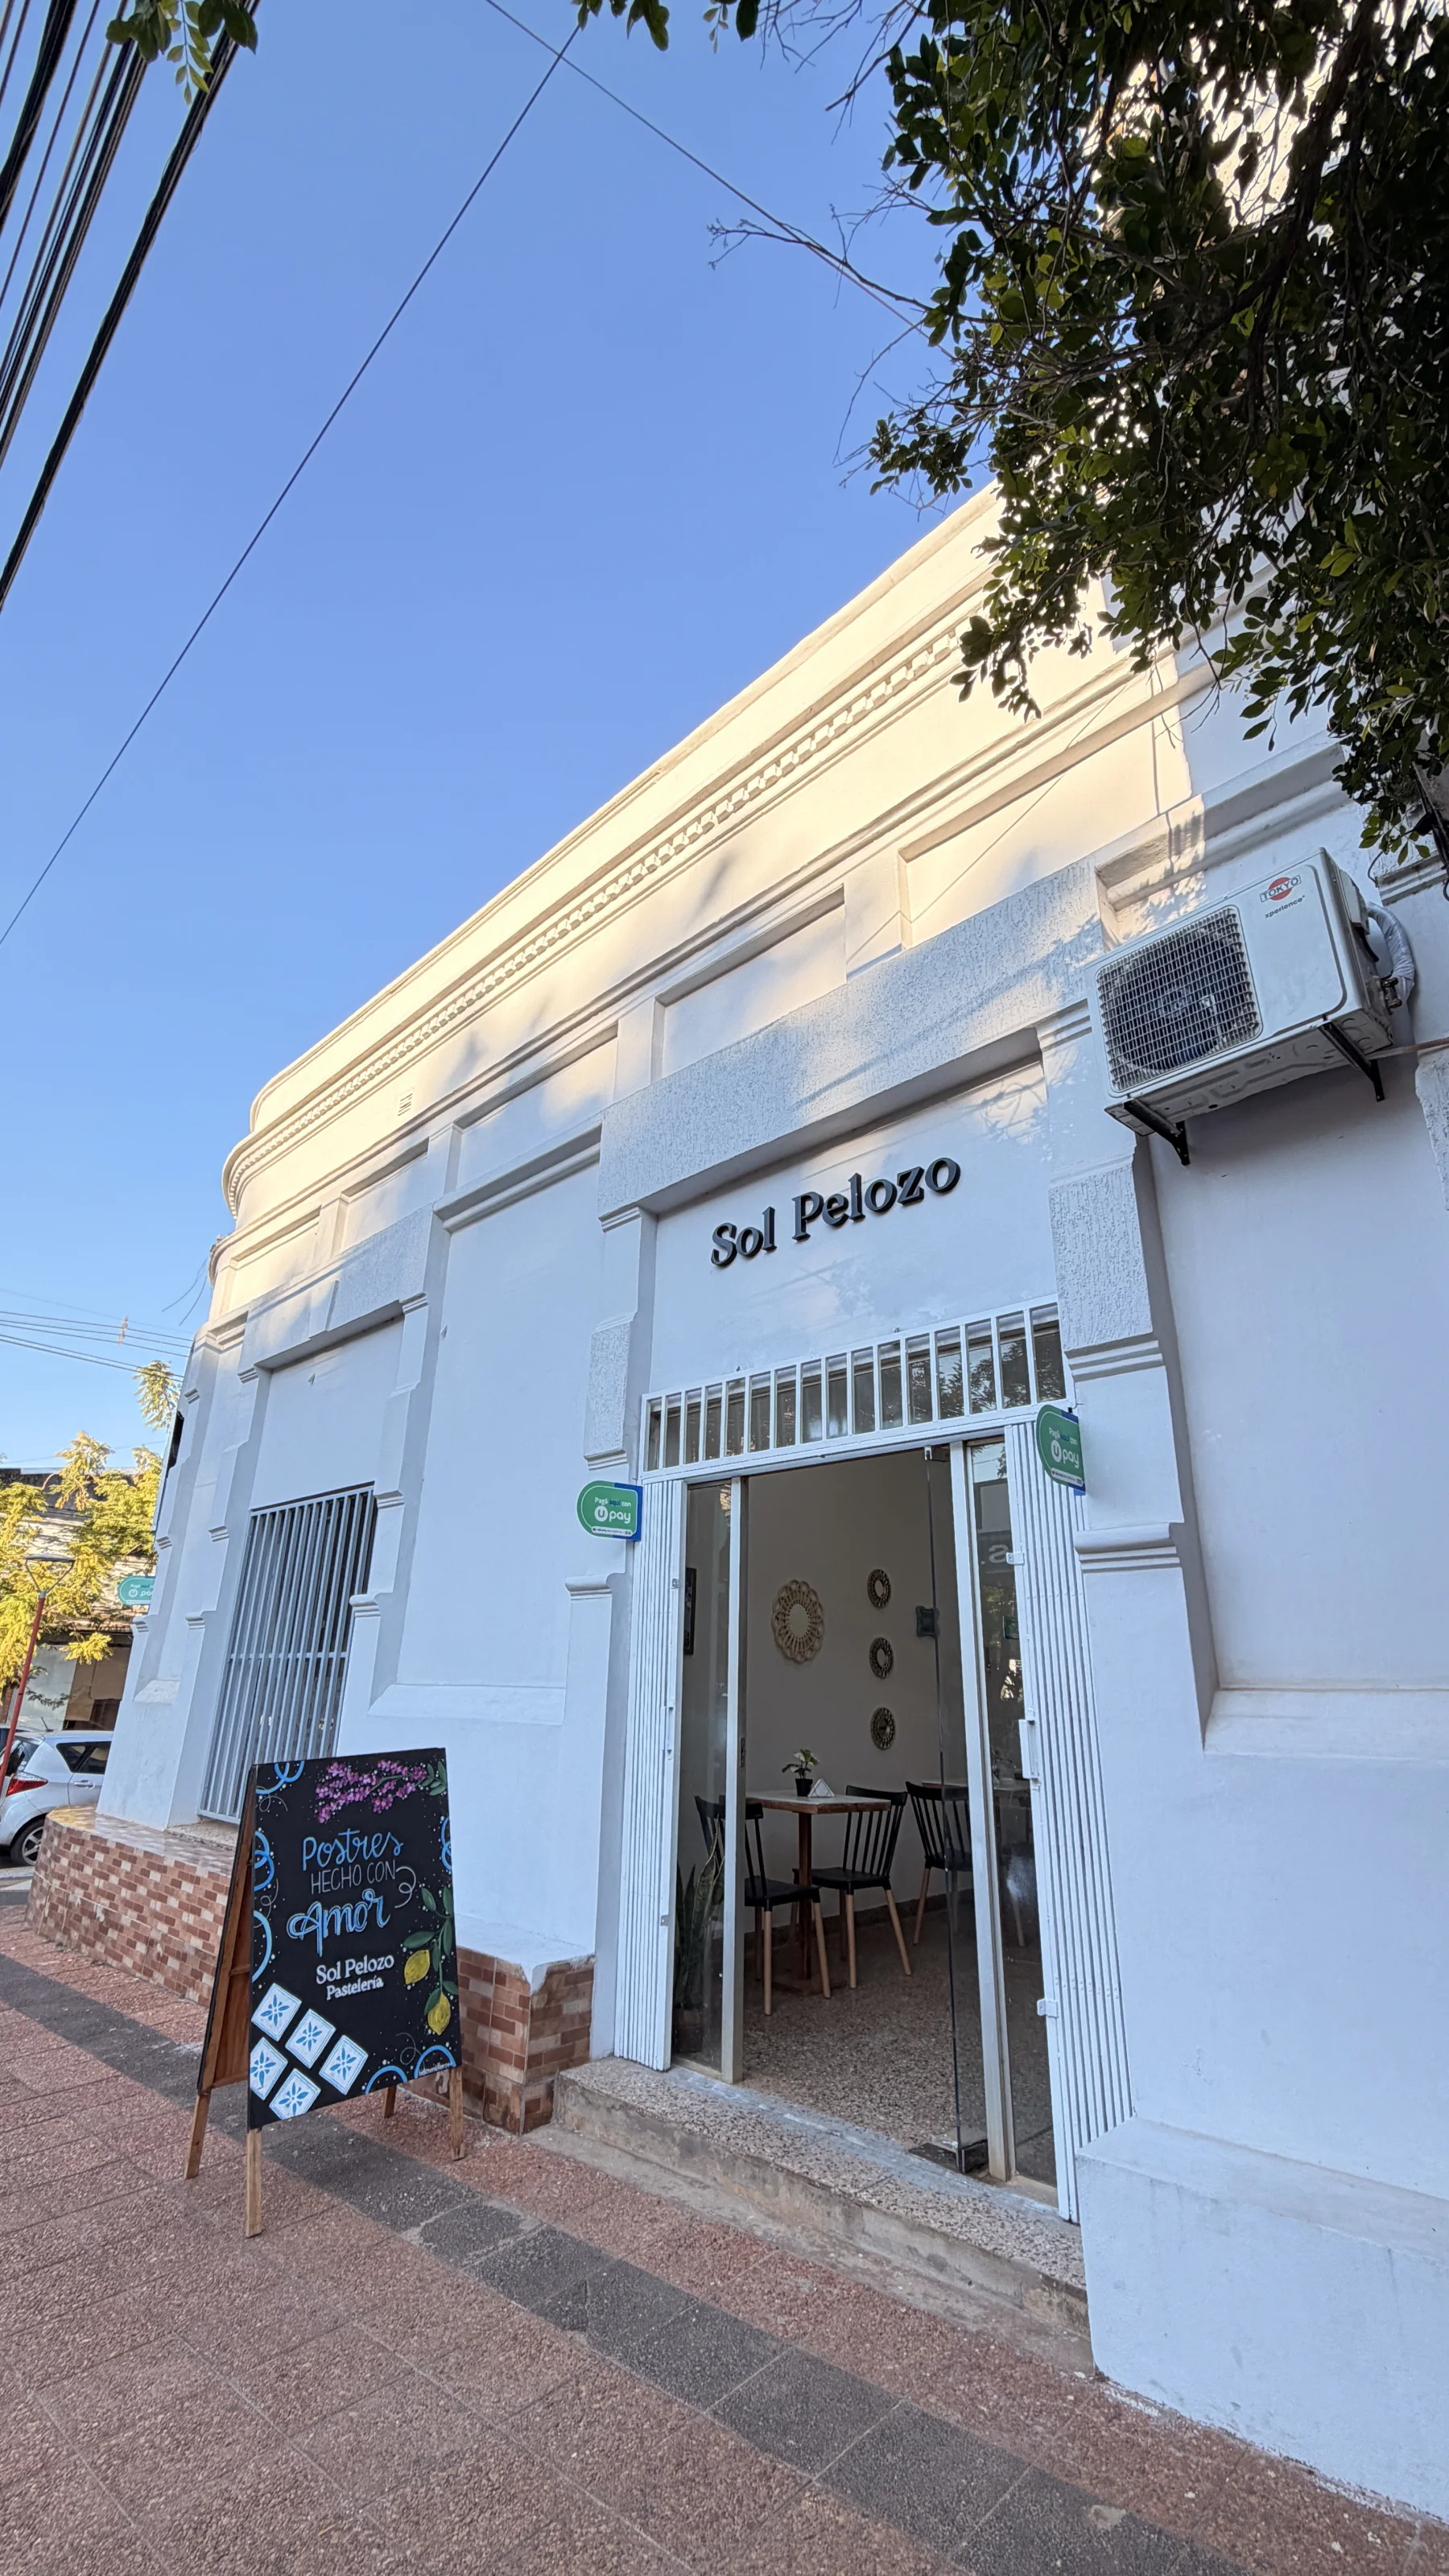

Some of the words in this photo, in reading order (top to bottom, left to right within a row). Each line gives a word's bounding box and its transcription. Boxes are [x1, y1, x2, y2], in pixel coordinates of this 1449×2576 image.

[1261, 877, 1299, 901] TOKYO
[711, 1206, 778, 1268] Sol
[791, 1157, 961, 1242] Pelozo
[595, 1496, 609, 1505] Pagá
[303, 1828, 404, 1872] Postres
[311, 1864, 362, 1895] HECHO
[367, 1859, 395, 1884] CON
[287, 1889, 390, 1957] Amor
[316, 1961, 342, 1984] Sol
[345, 1955, 394, 1978] Pelozo
[326, 1975, 384, 2000] Pastelería
